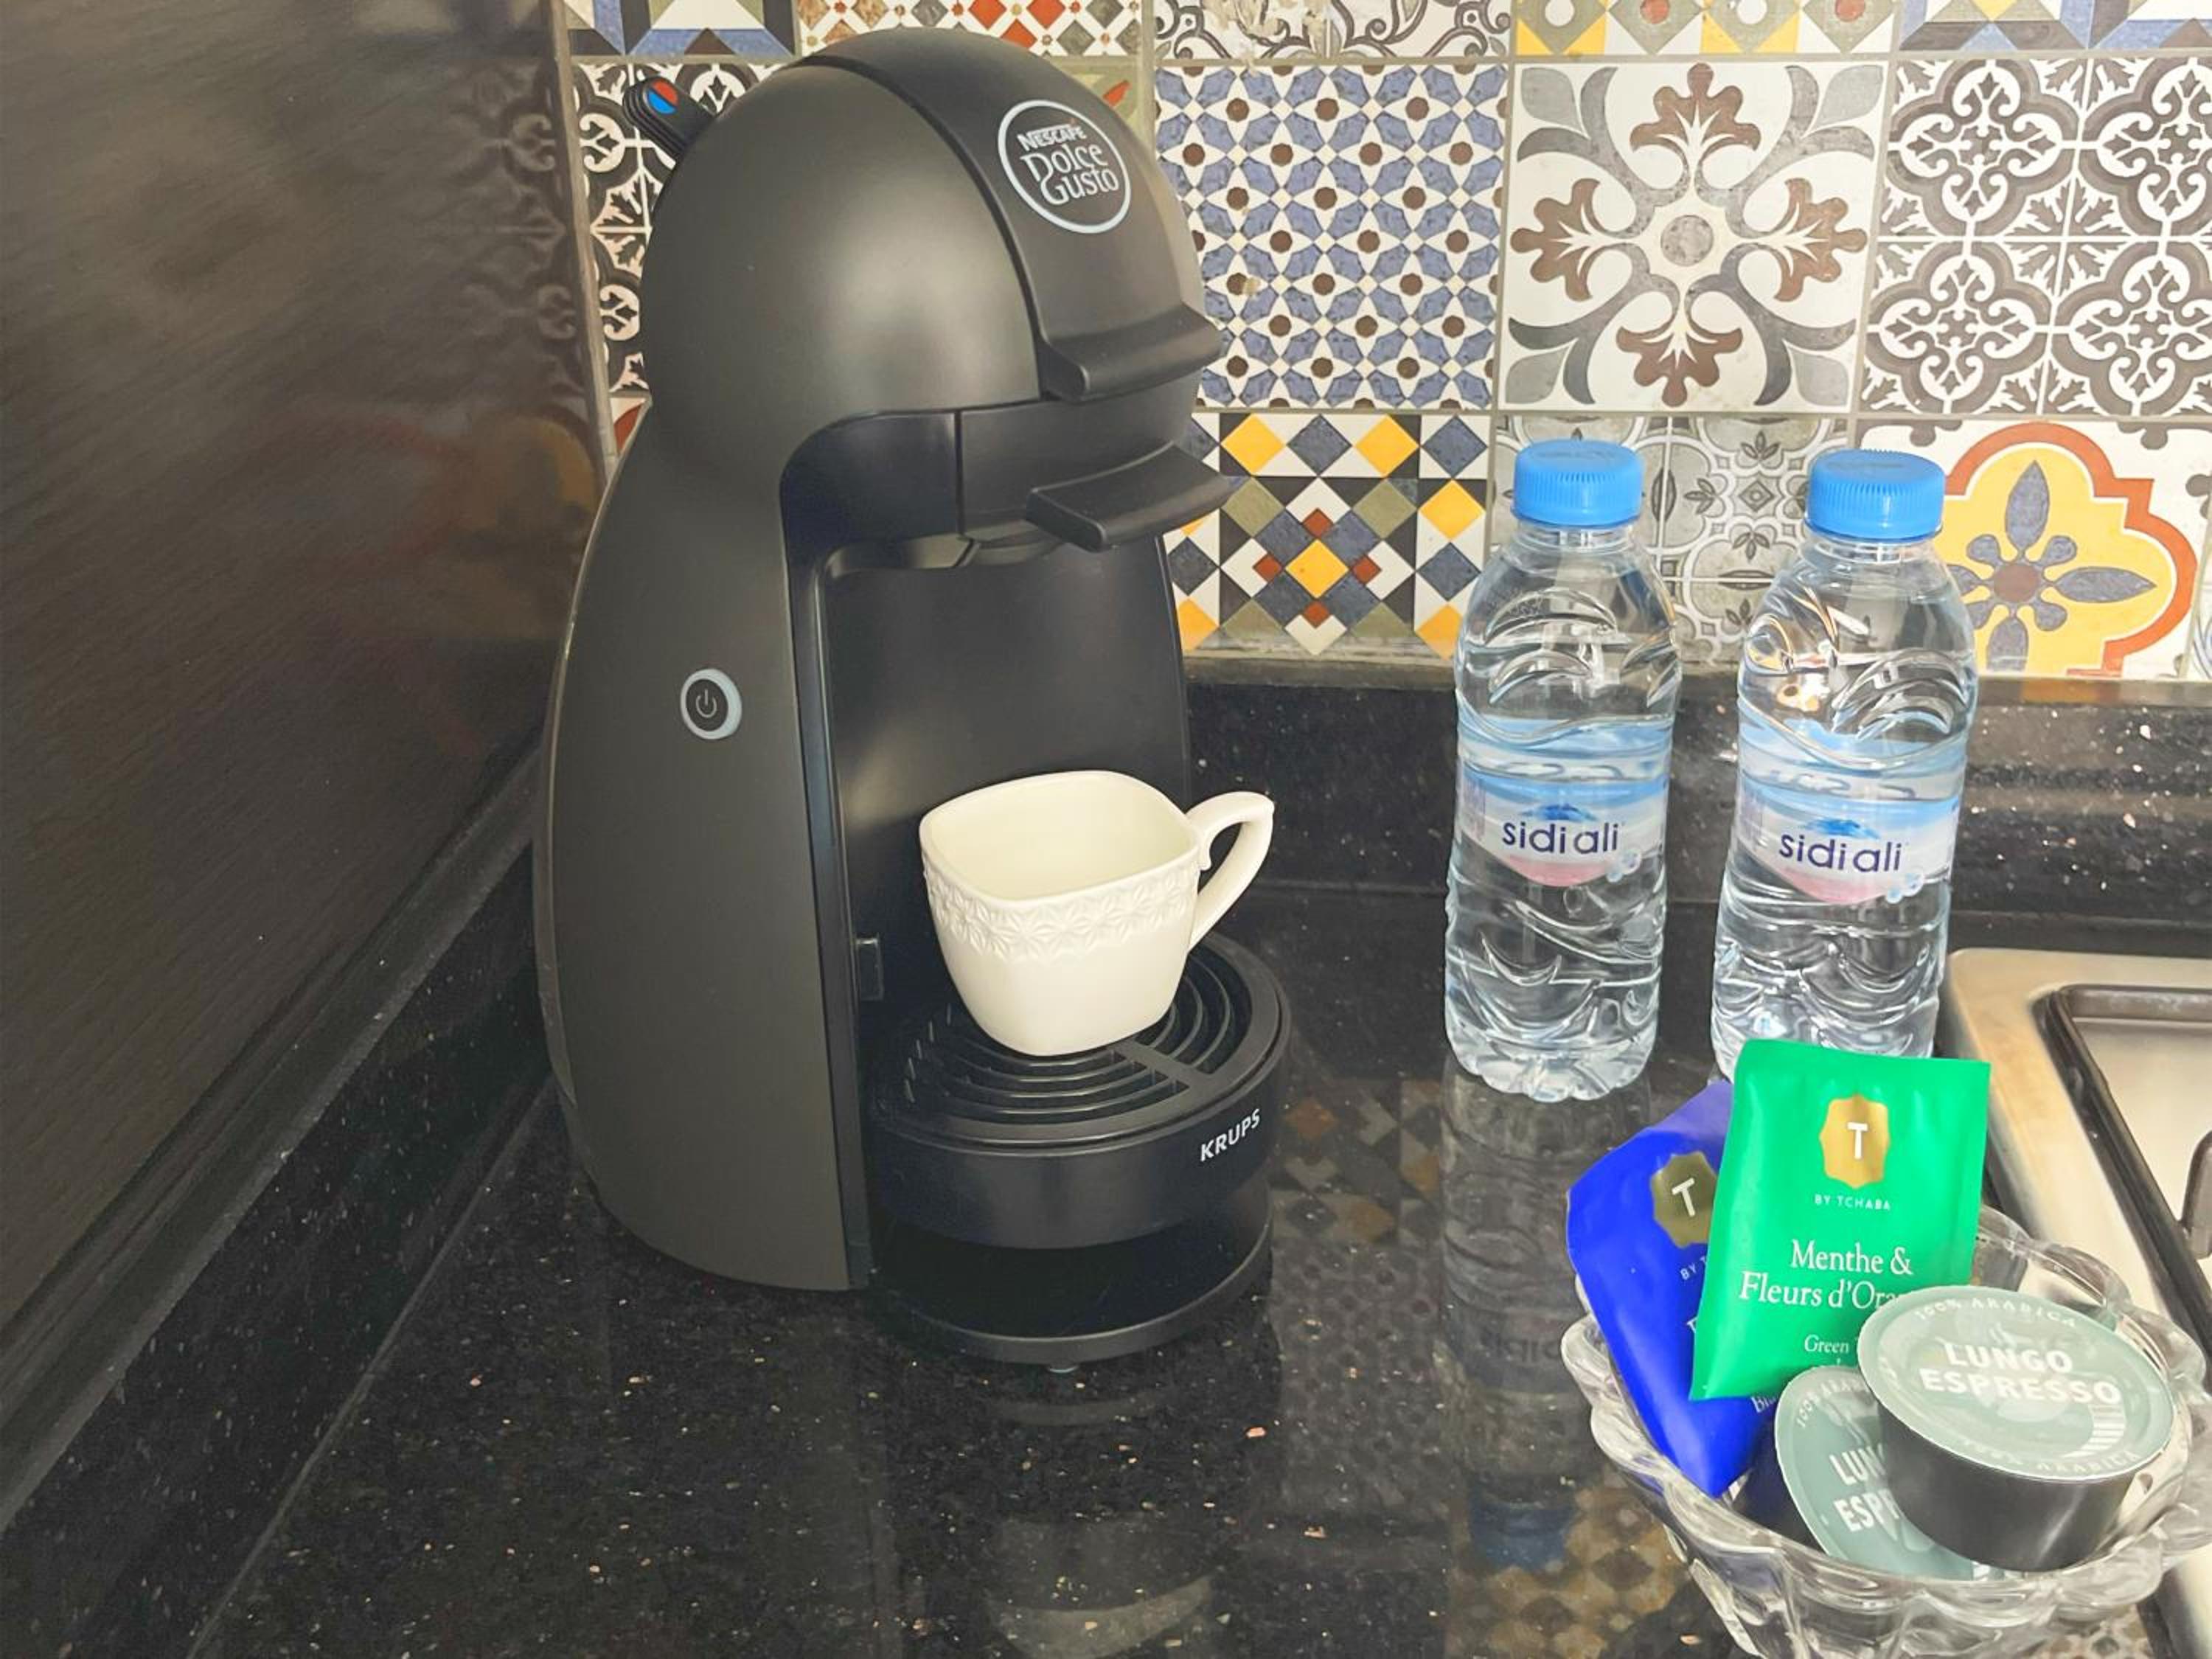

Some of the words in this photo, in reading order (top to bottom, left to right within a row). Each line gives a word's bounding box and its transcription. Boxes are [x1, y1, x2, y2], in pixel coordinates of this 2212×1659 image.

[1020, 143, 1108, 181] Dolce
[1040, 167, 1119, 205] Gusto
[1502, 821, 1566, 854] sidi
[1573, 823, 1618, 855] ali
[1779, 834, 1847, 871] sidi
[1853, 841, 1902, 872] ali
[1200, 1108, 1260, 1162] KRUPS
[1847, 1121, 1868, 1160] T
[1672, 1178, 1696, 1217] T
[1814, 1194, 1832, 1206] BY
[1837, 1195, 1891, 1211] TCHABA
[1790, 1239, 1885, 1274] Menthe
[1890, 1246, 1913, 1276] &
[1739, 1270, 1823, 1307] Fleurs
[1804, 1334, 1850, 1354] Green
[1942, 1342, 2074, 1374] LUNGO
[1919, 1367, 2123, 1405] ESPRESSO
[1829, 1442, 1886, 1486] LUN
